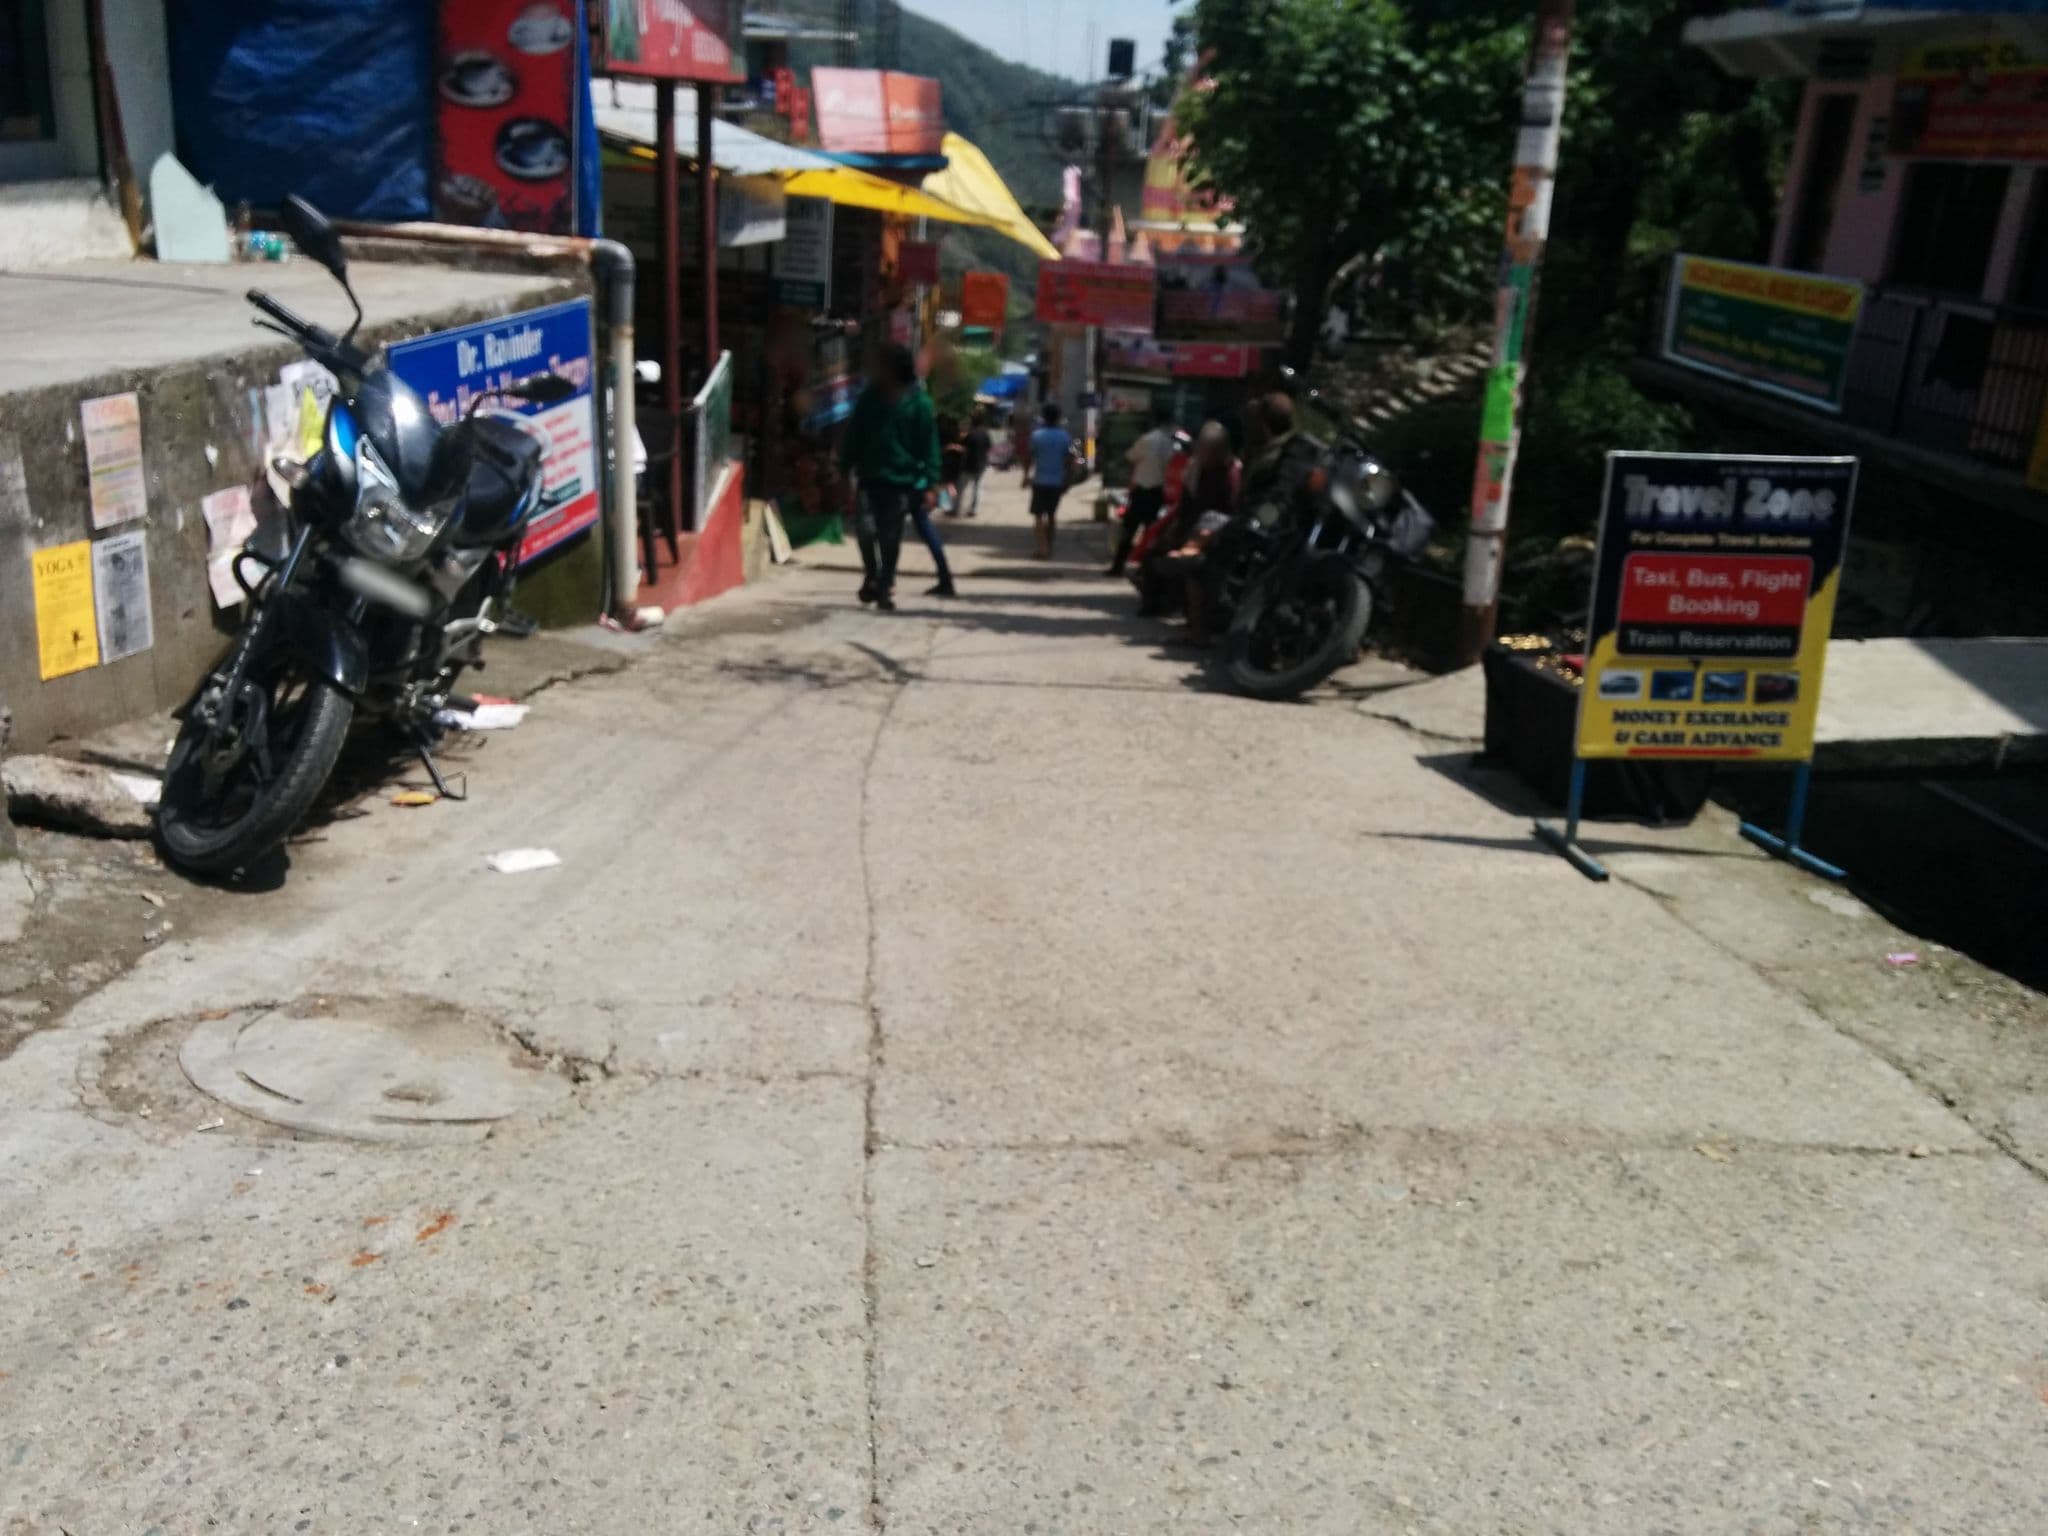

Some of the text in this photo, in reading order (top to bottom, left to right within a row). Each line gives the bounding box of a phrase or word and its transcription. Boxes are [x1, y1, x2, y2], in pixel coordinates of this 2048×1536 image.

[457, 339, 483, 378] Dr.
[1624, 474, 1836, 519] Travel Zone
[1630, 531, 1653, 544] For
[1718, 533, 1755, 546] Travel
[36, 558, 76, 577] YOGA
[1741, 570, 1802, 593] Flight
[1669, 595, 1760, 620] Booking
[1628, 631, 1792, 650] Train Reservation
[1613, 708, 1790, 727] MONEY EXCHANGE
[1615, 730, 1782, 747] & CASH ADVANCE
